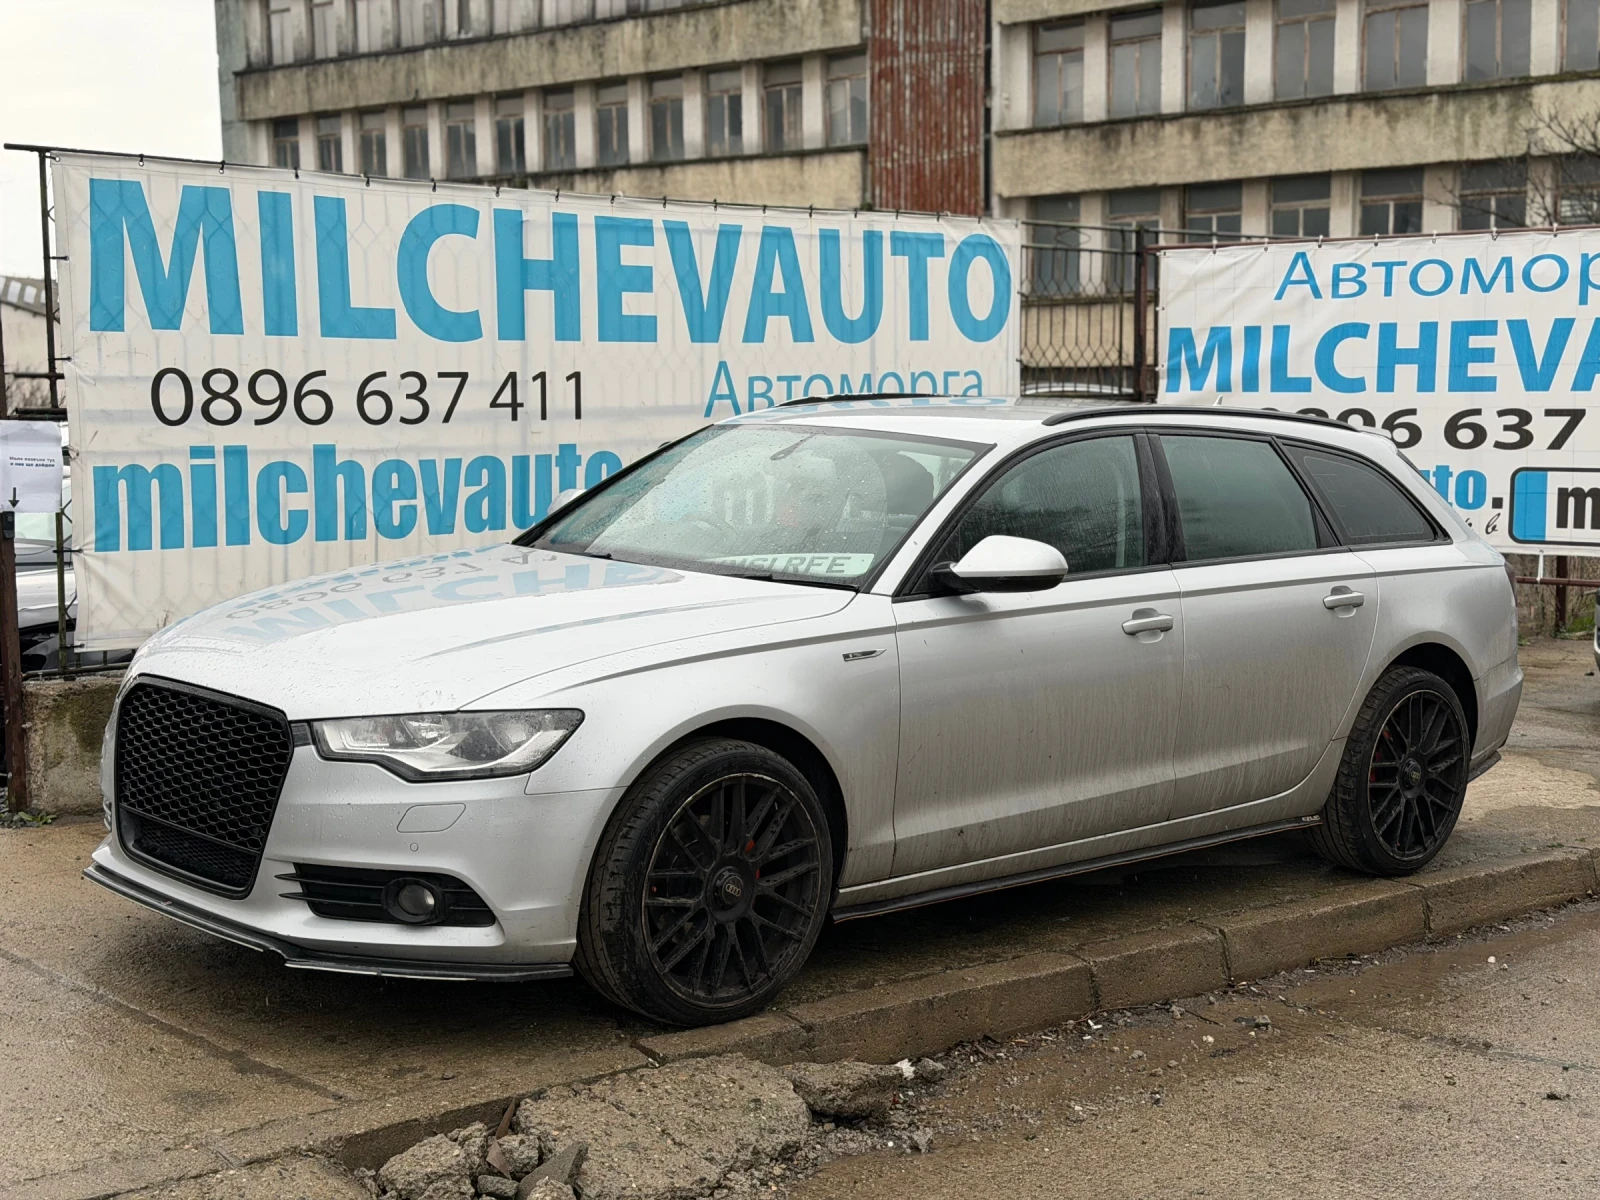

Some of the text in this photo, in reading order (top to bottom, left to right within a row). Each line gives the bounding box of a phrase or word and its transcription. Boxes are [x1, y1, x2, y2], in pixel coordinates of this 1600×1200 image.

[89, 178, 1011, 344] MILCHEVAUTO
[151, 367, 584, 427] 0896 637 411
[1443, 407, 1587, 451] 637
